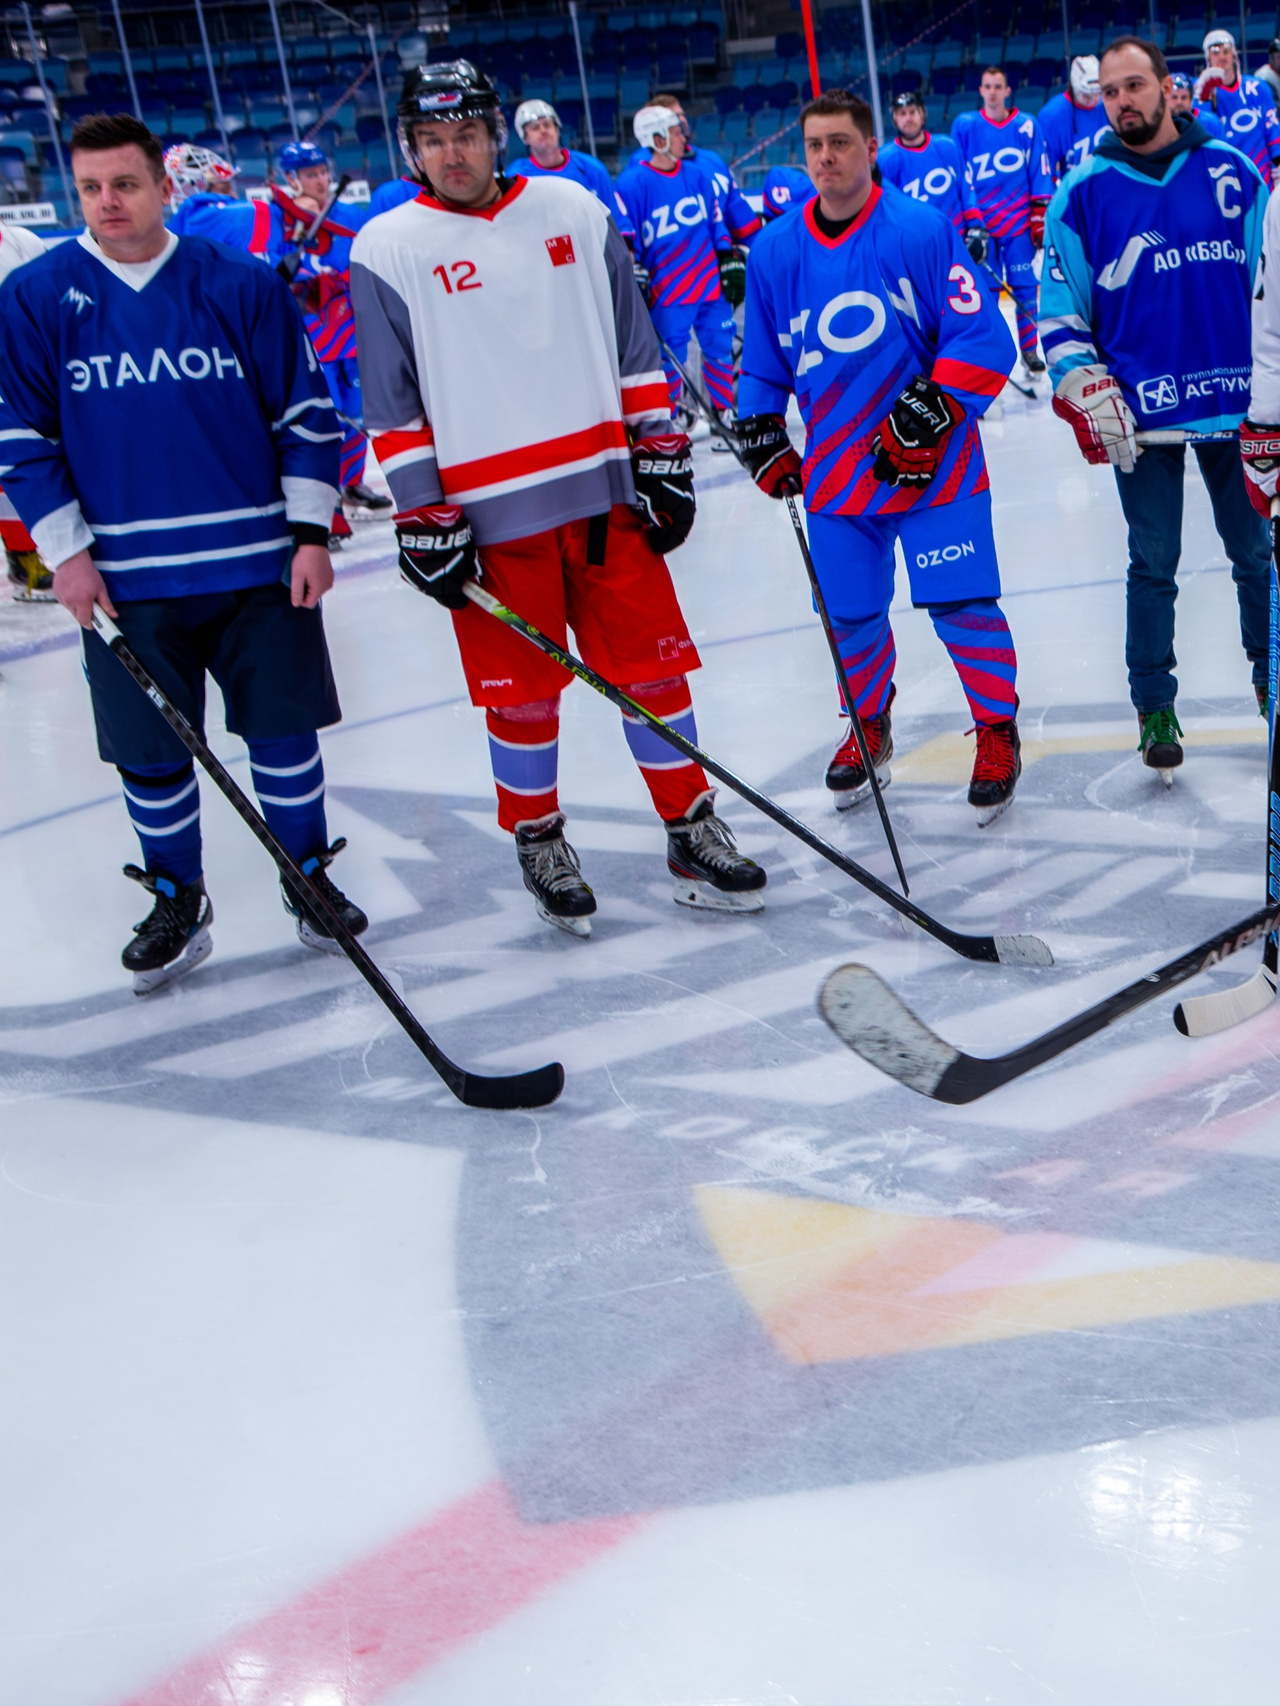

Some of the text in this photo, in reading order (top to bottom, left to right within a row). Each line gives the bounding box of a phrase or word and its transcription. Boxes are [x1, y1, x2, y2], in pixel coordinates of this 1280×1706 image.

[432, 260, 483, 295] 12
[1153, 248, 1182, 274] АО
[947, 262, 982, 316] 3
[65, 346, 246, 392] ЭТАЛОН
[899, 389, 941, 427] UER
[916, 539, 976, 569] OZON
[548, 651, 607, 696] ALPHA
